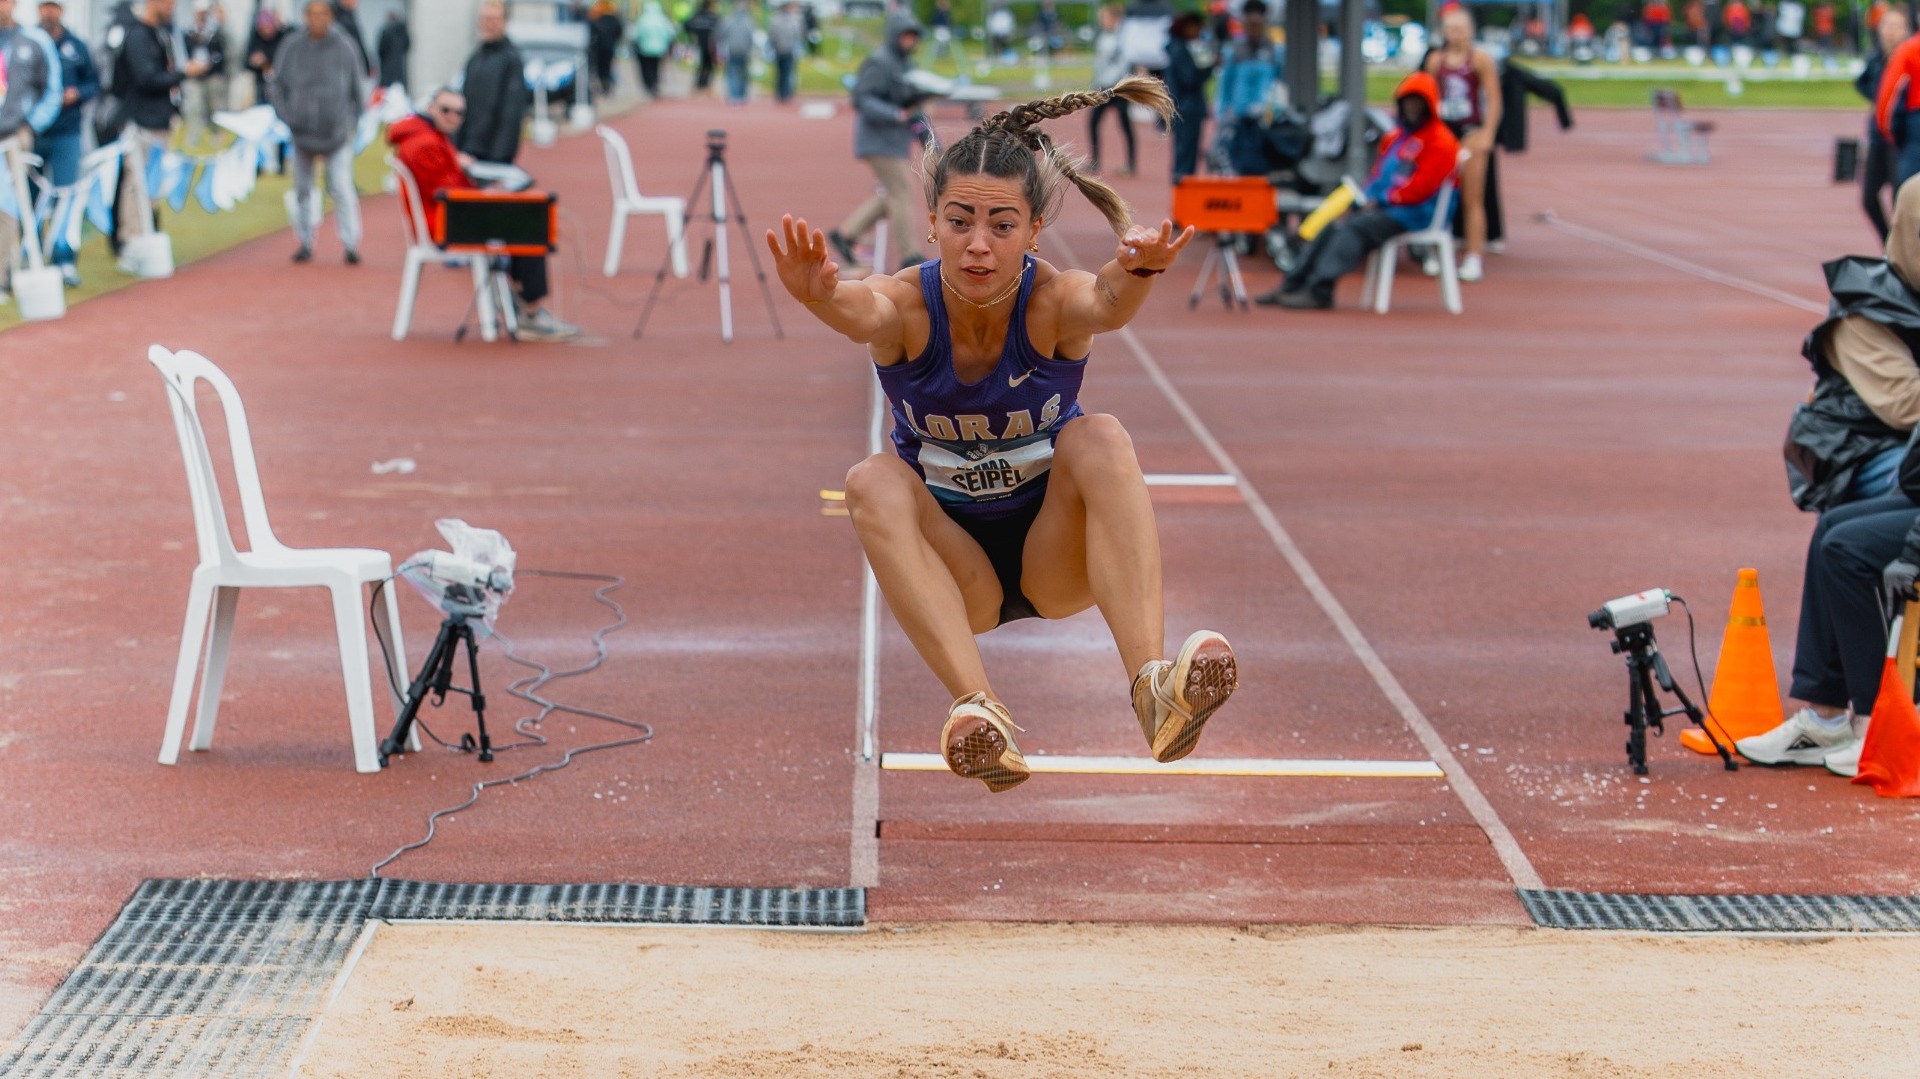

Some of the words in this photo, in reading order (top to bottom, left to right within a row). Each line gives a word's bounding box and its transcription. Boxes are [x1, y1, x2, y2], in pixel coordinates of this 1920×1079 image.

[903, 393, 1061, 441] LORAS
[956, 458, 1012, 471] MA
[951, 469, 1027, 492] SEIPEL
